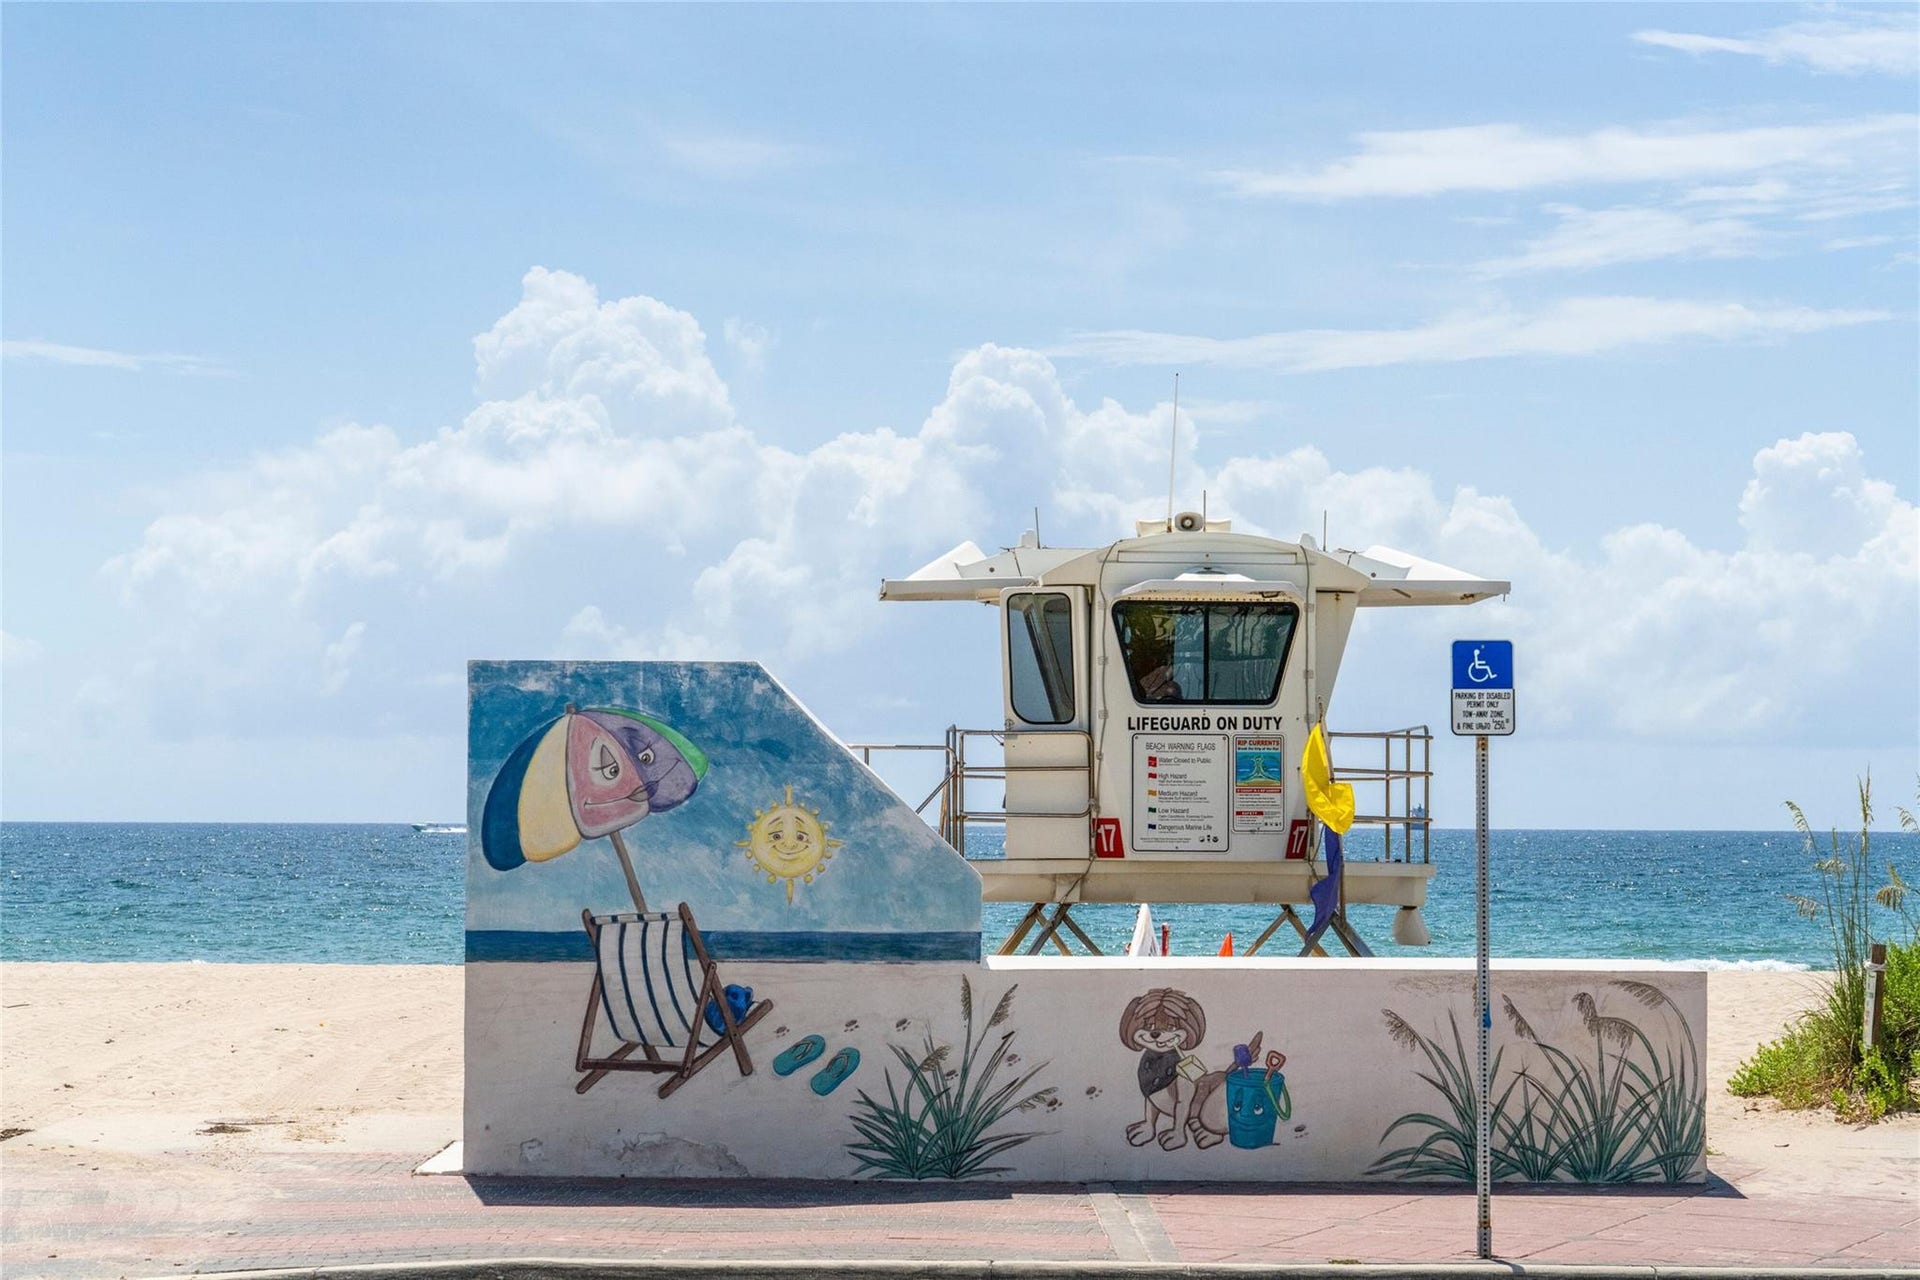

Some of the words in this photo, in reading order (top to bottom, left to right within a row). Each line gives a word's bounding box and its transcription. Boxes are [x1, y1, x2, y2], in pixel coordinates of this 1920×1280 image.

[1455, 692, 1476, 700] PARKING
[1478, 692, 1485, 700] BY
[1486, 692, 1511, 700] DISABLED
[1466, 700, 1485, 708] PERMIT
[1486, 700, 1499, 708] ONLY
[1462, 710, 1488, 718] TOW-AWAY
[1490, 710, 1504, 718] ZONE
[1127, 716, 1211, 731] LIFEGUARD
[1217, 716, 1237, 730] ON
[1243, 716, 1283, 730] DUTY
[1462, 722, 1474, 730] FINE
[1145, 742, 1165, 750] BEACH
[1168, 742, 1195, 751] WARNING
[1197, 742, 1216, 751] FLAGS
[1097, 824, 1116, 852] 17
[1293, 825, 1308, 853] 17
